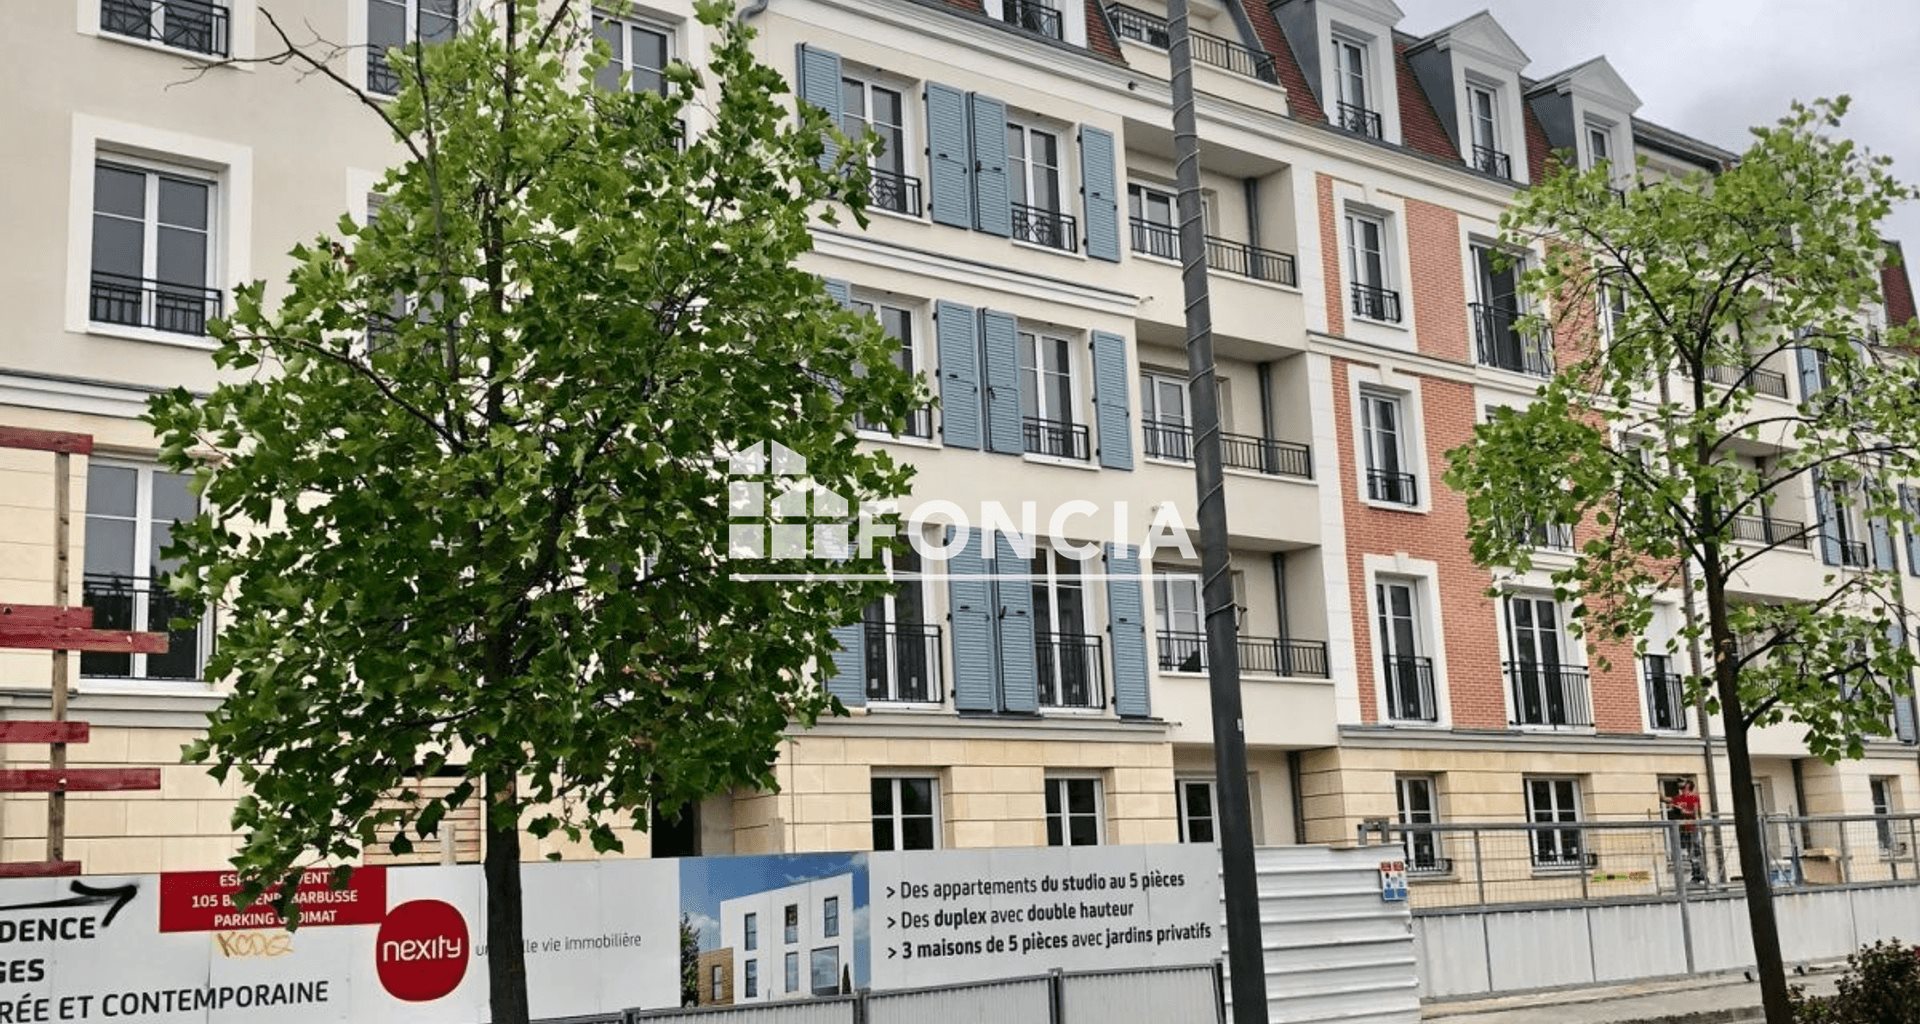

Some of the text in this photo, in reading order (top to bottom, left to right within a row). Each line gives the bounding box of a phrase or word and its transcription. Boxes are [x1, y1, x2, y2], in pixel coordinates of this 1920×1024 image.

[900, 881, 929, 899] Des
[933, 878, 1038, 901] appartements
[1041, 874, 1059, 893] du
[1062, 872, 1106, 892] studio
[1109, 876, 1126, 890] au
[1129, 872, 1138, 888] 5
[1141, 870, 1185, 892] pièces
[191, 896, 218, 908] 105
[901, 911, 930, 930] Des
[934, 908, 987, 931] duplex
[990, 908, 1024, 924] avec
[1027, 904, 1076, 922] double
[1079, 901, 1134, 919] hauteur
[0, 916, 96, 944] DENCE
[214, 912, 275, 928] PARKING
[382, 934, 462, 962] nexity
[542, 936, 561, 952] vie
[565, 930, 642, 950] immobilière
[902, 940, 912, 960] 3
[917, 938, 983, 958] maisons
[986, 935, 1004, 954] de
[1008, 934, 1018, 951] 5
[1022, 931, 1069, 955] pièces
[1072, 932, 1103, 948] avec
[1105, 926, 1153, 949] jardins
[1157, 922, 1212, 946] privatifs
[59, 995, 94, 1020] ET
[102, 981, 329, 1018] CONTEMPORAINE
